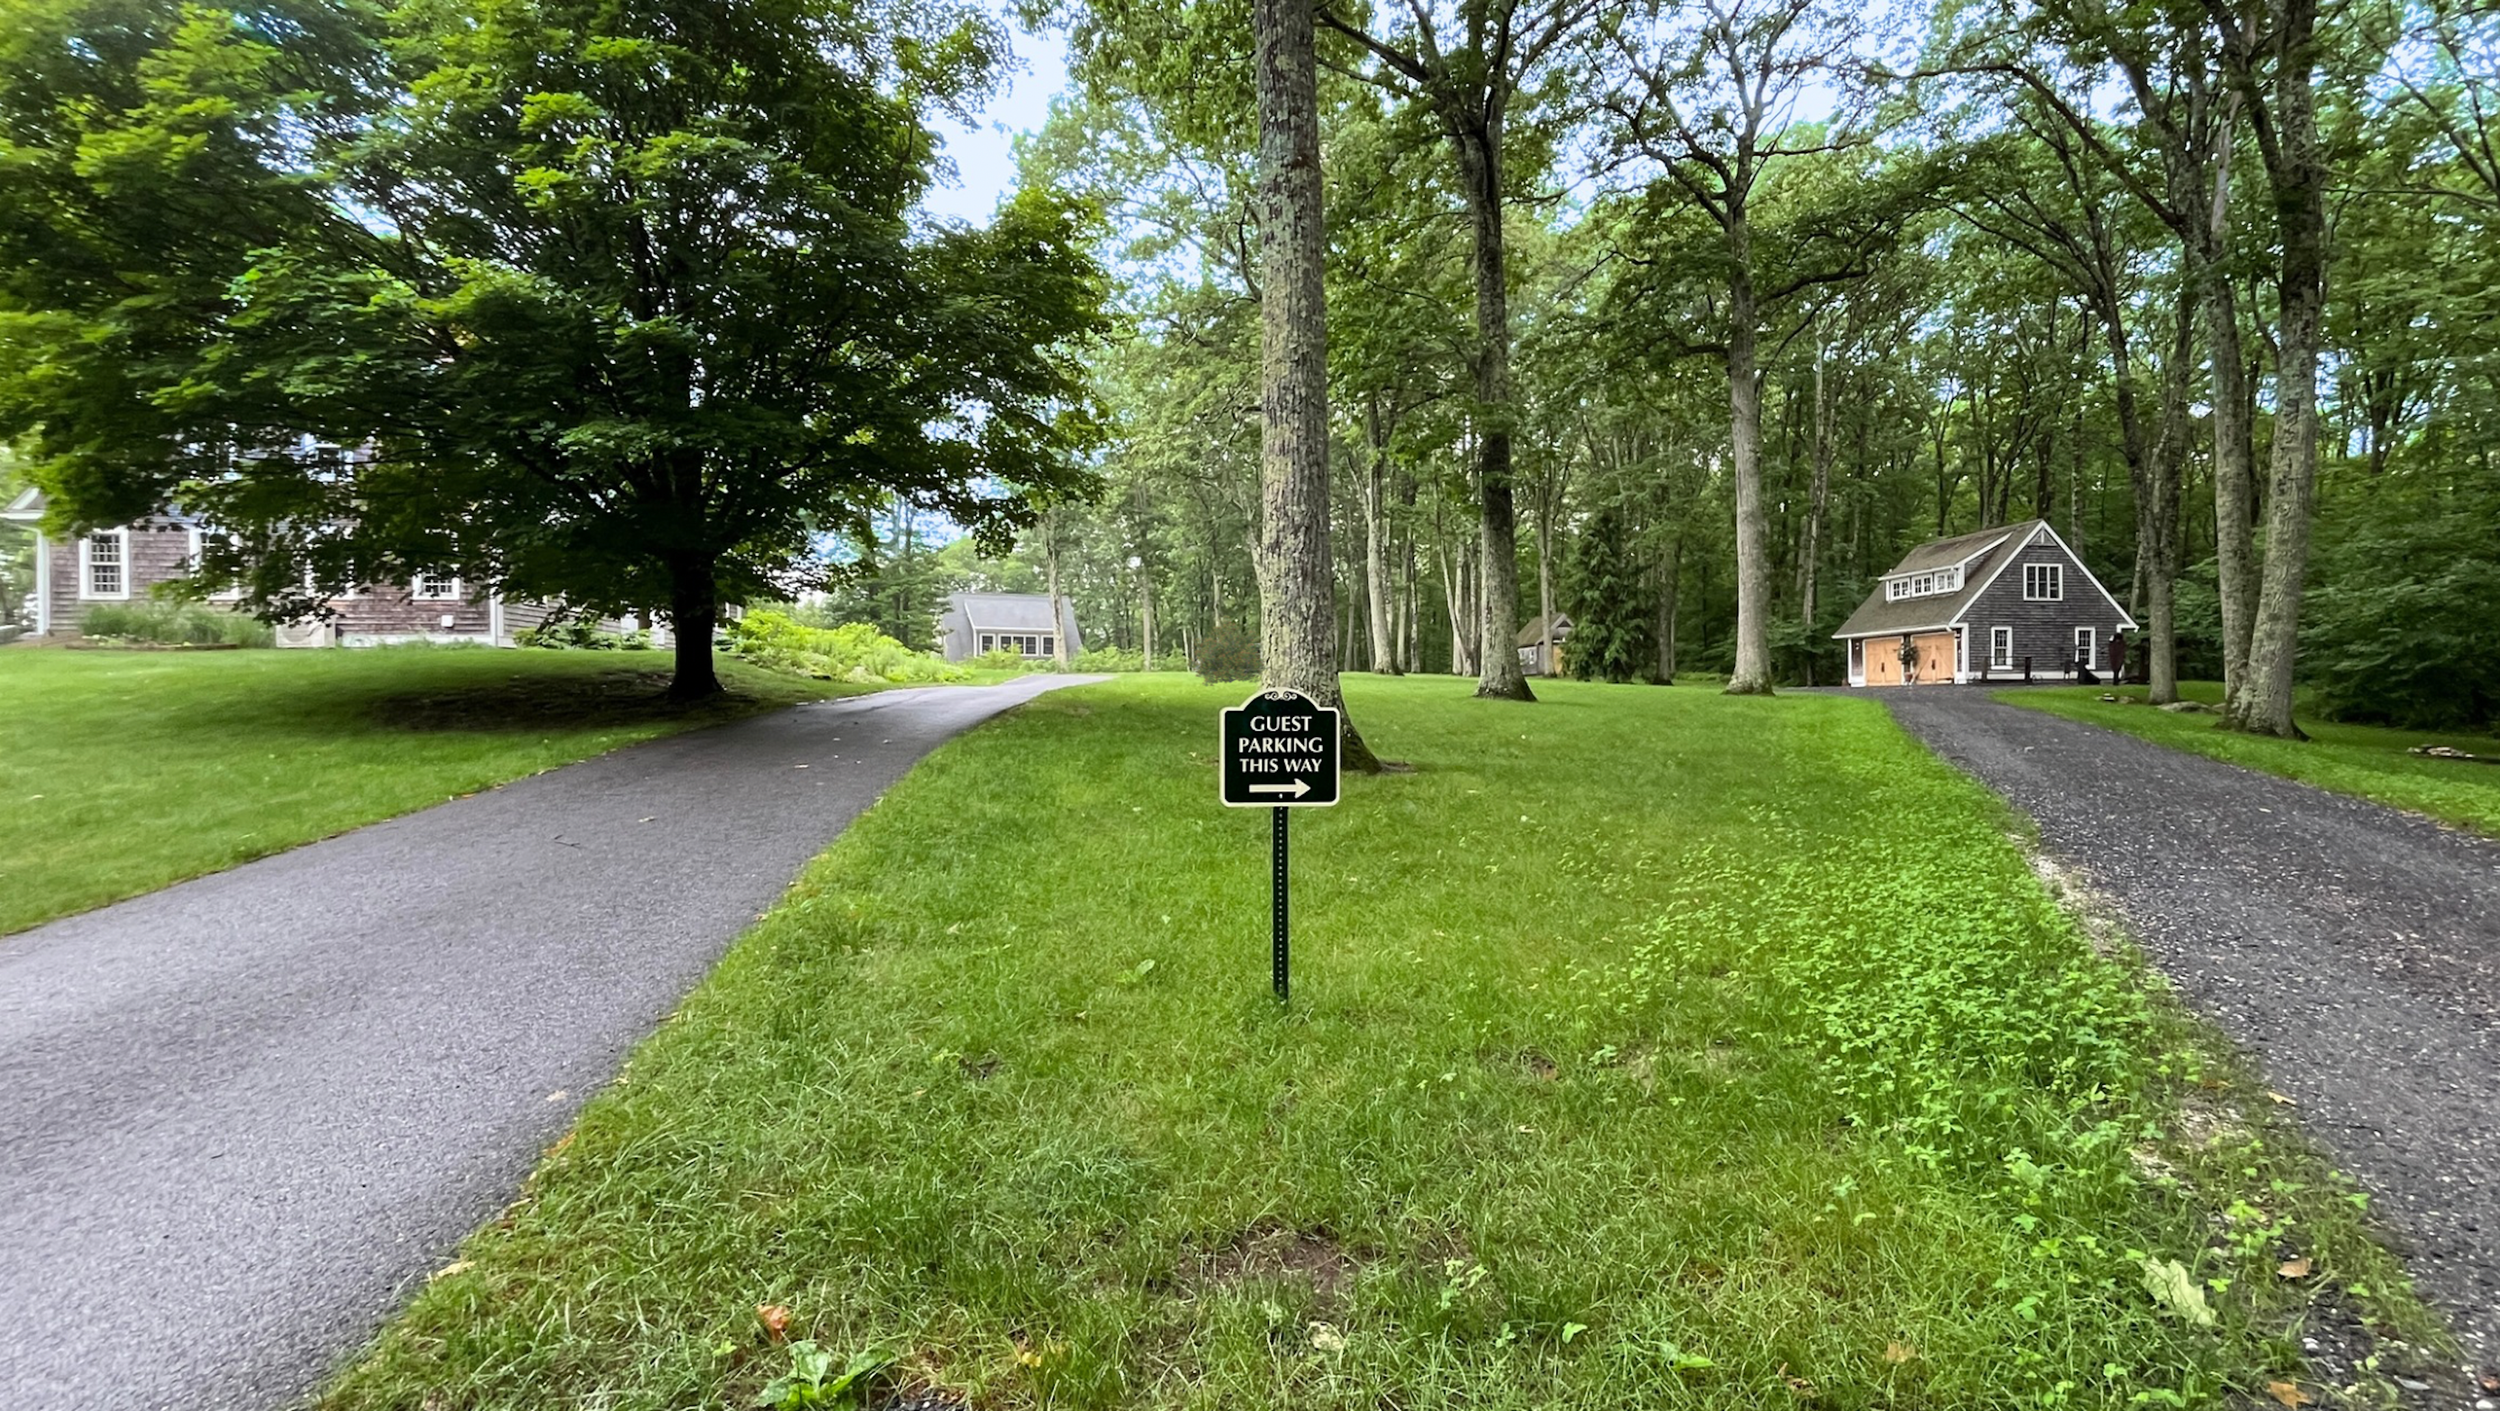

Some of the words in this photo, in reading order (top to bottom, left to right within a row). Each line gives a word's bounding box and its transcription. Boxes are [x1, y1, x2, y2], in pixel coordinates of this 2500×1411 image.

[1250, 716, 1312, 732] GUEST
[1238, 737, 1324, 753] PARKING
[1239, 758, 1279, 773] THIS
[1283, 758, 1322, 773] WAY
